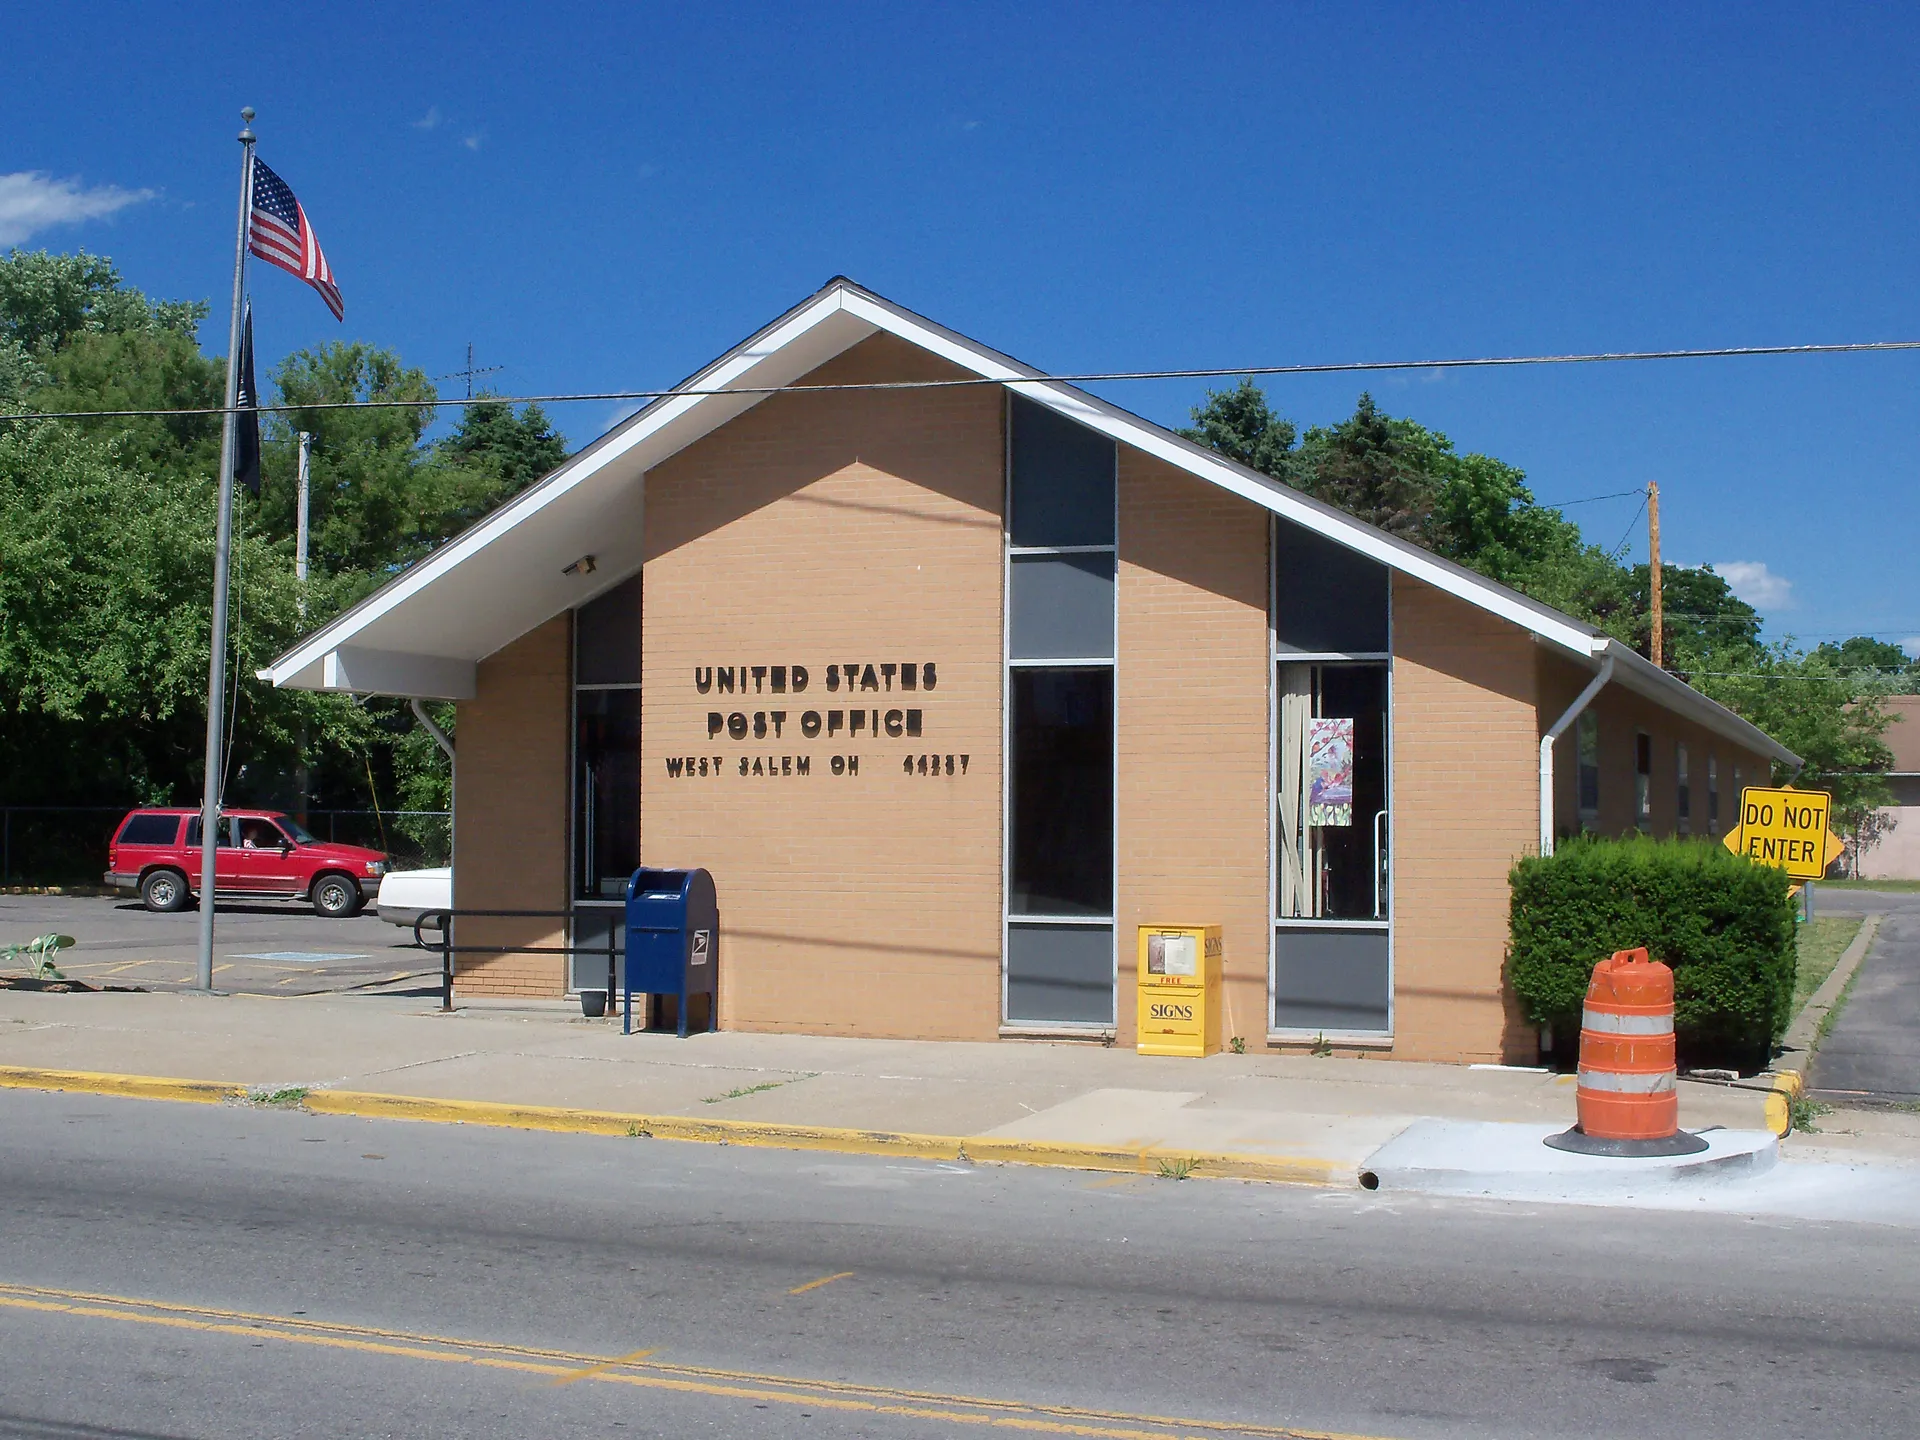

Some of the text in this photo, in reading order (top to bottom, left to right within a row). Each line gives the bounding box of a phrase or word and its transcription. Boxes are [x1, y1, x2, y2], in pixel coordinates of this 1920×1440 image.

[695, 662, 938, 695] UNITED STATES
[707, 708, 923, 740] POST OFFICE
[665, 756, 723, 778] WEST
[738, 756, 811, 777] SALEM
[830, 755, 859, 777] OH
[1745, 803, 1825, 830] DO NOT
[1749, 836, 1815, 863] ENTER
[1150, 1003, 1193, 1018] SIGNS
